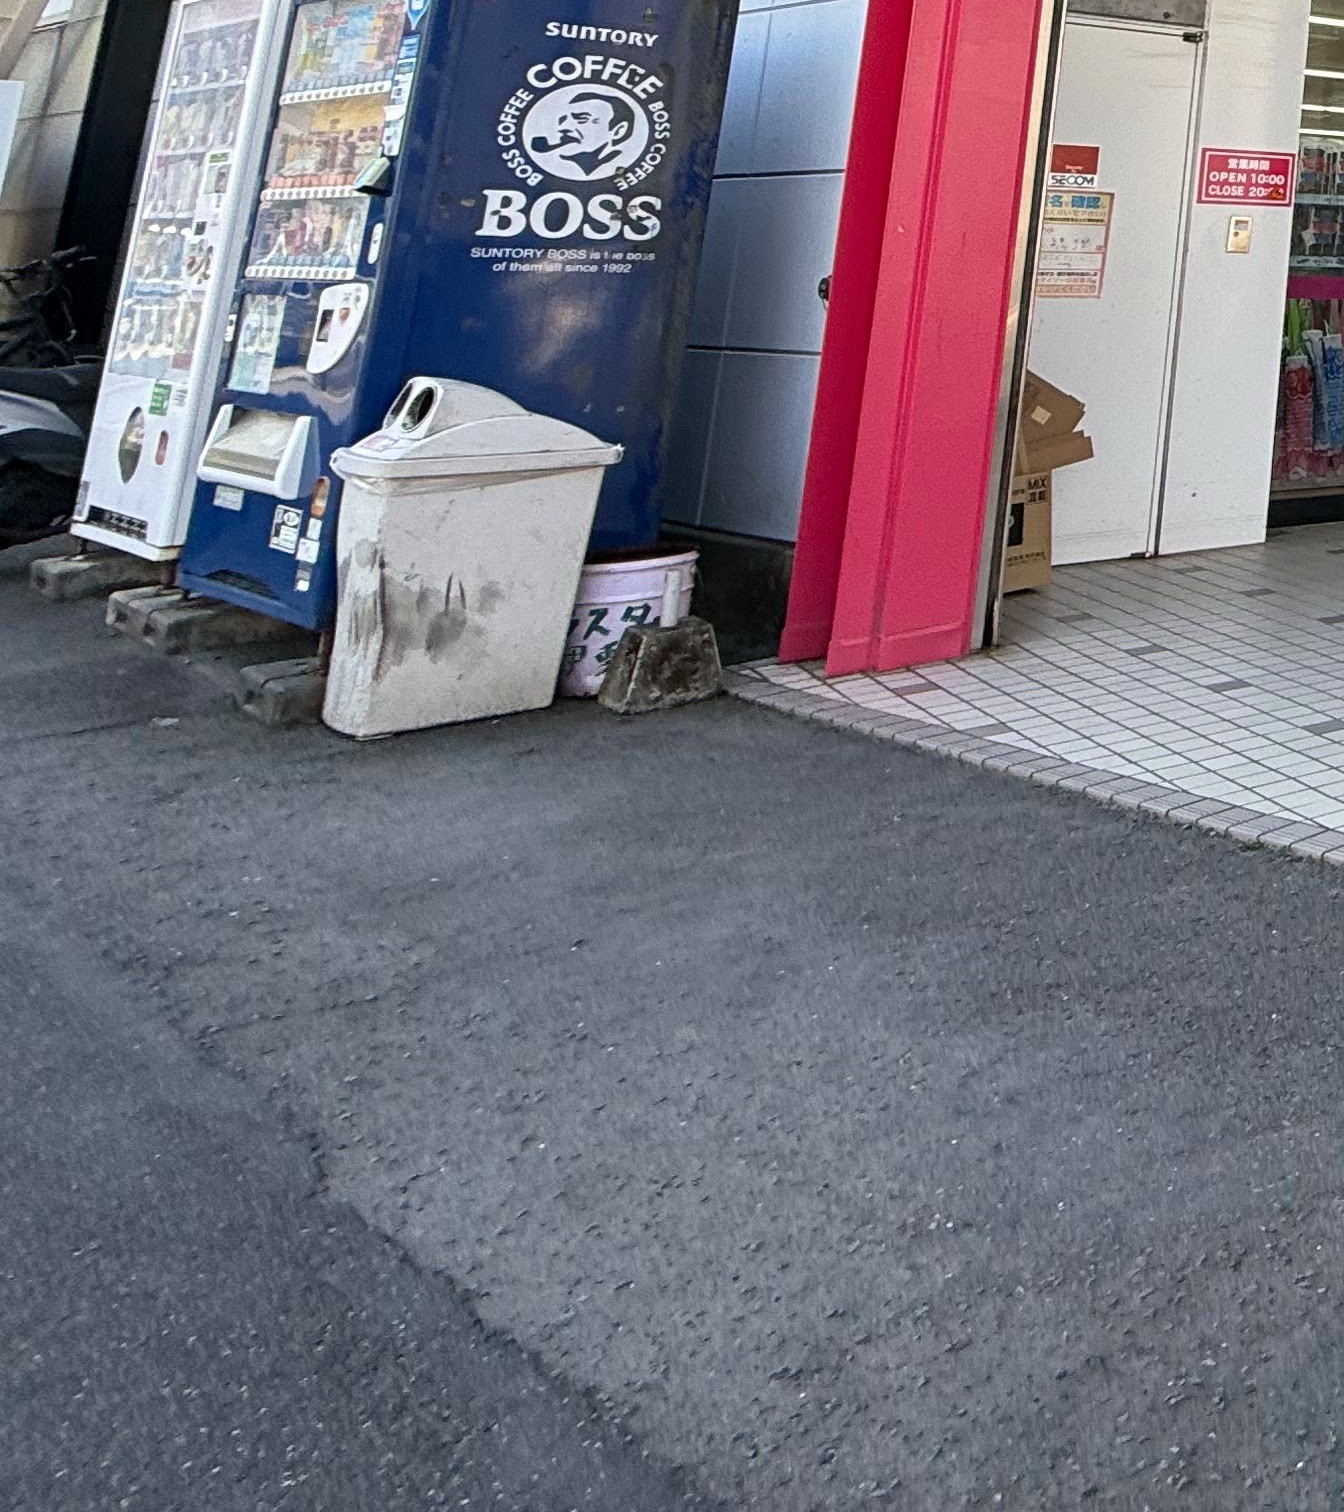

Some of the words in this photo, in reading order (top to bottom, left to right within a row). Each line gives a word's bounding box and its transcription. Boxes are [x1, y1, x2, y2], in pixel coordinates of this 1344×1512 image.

[545, 21, 660, 47] SUNTORY
[526, 54, 664, 100] COFFEE
[1227, 157, 1271, 171] 営業時間
[1051, 175, 1095, 187] SECOM
[1209, 172, 1247, 184] OPEN
[1250, 173, 1285, 185] 10:00
[1208, 185, 1245, 197] CLOSE
[475, 188, 663, 241] BOSS
[470, 247, 545, 260] SUNTORY
[547, 248, 587, 261] BOSS
[564, 263, 599, 273] since
